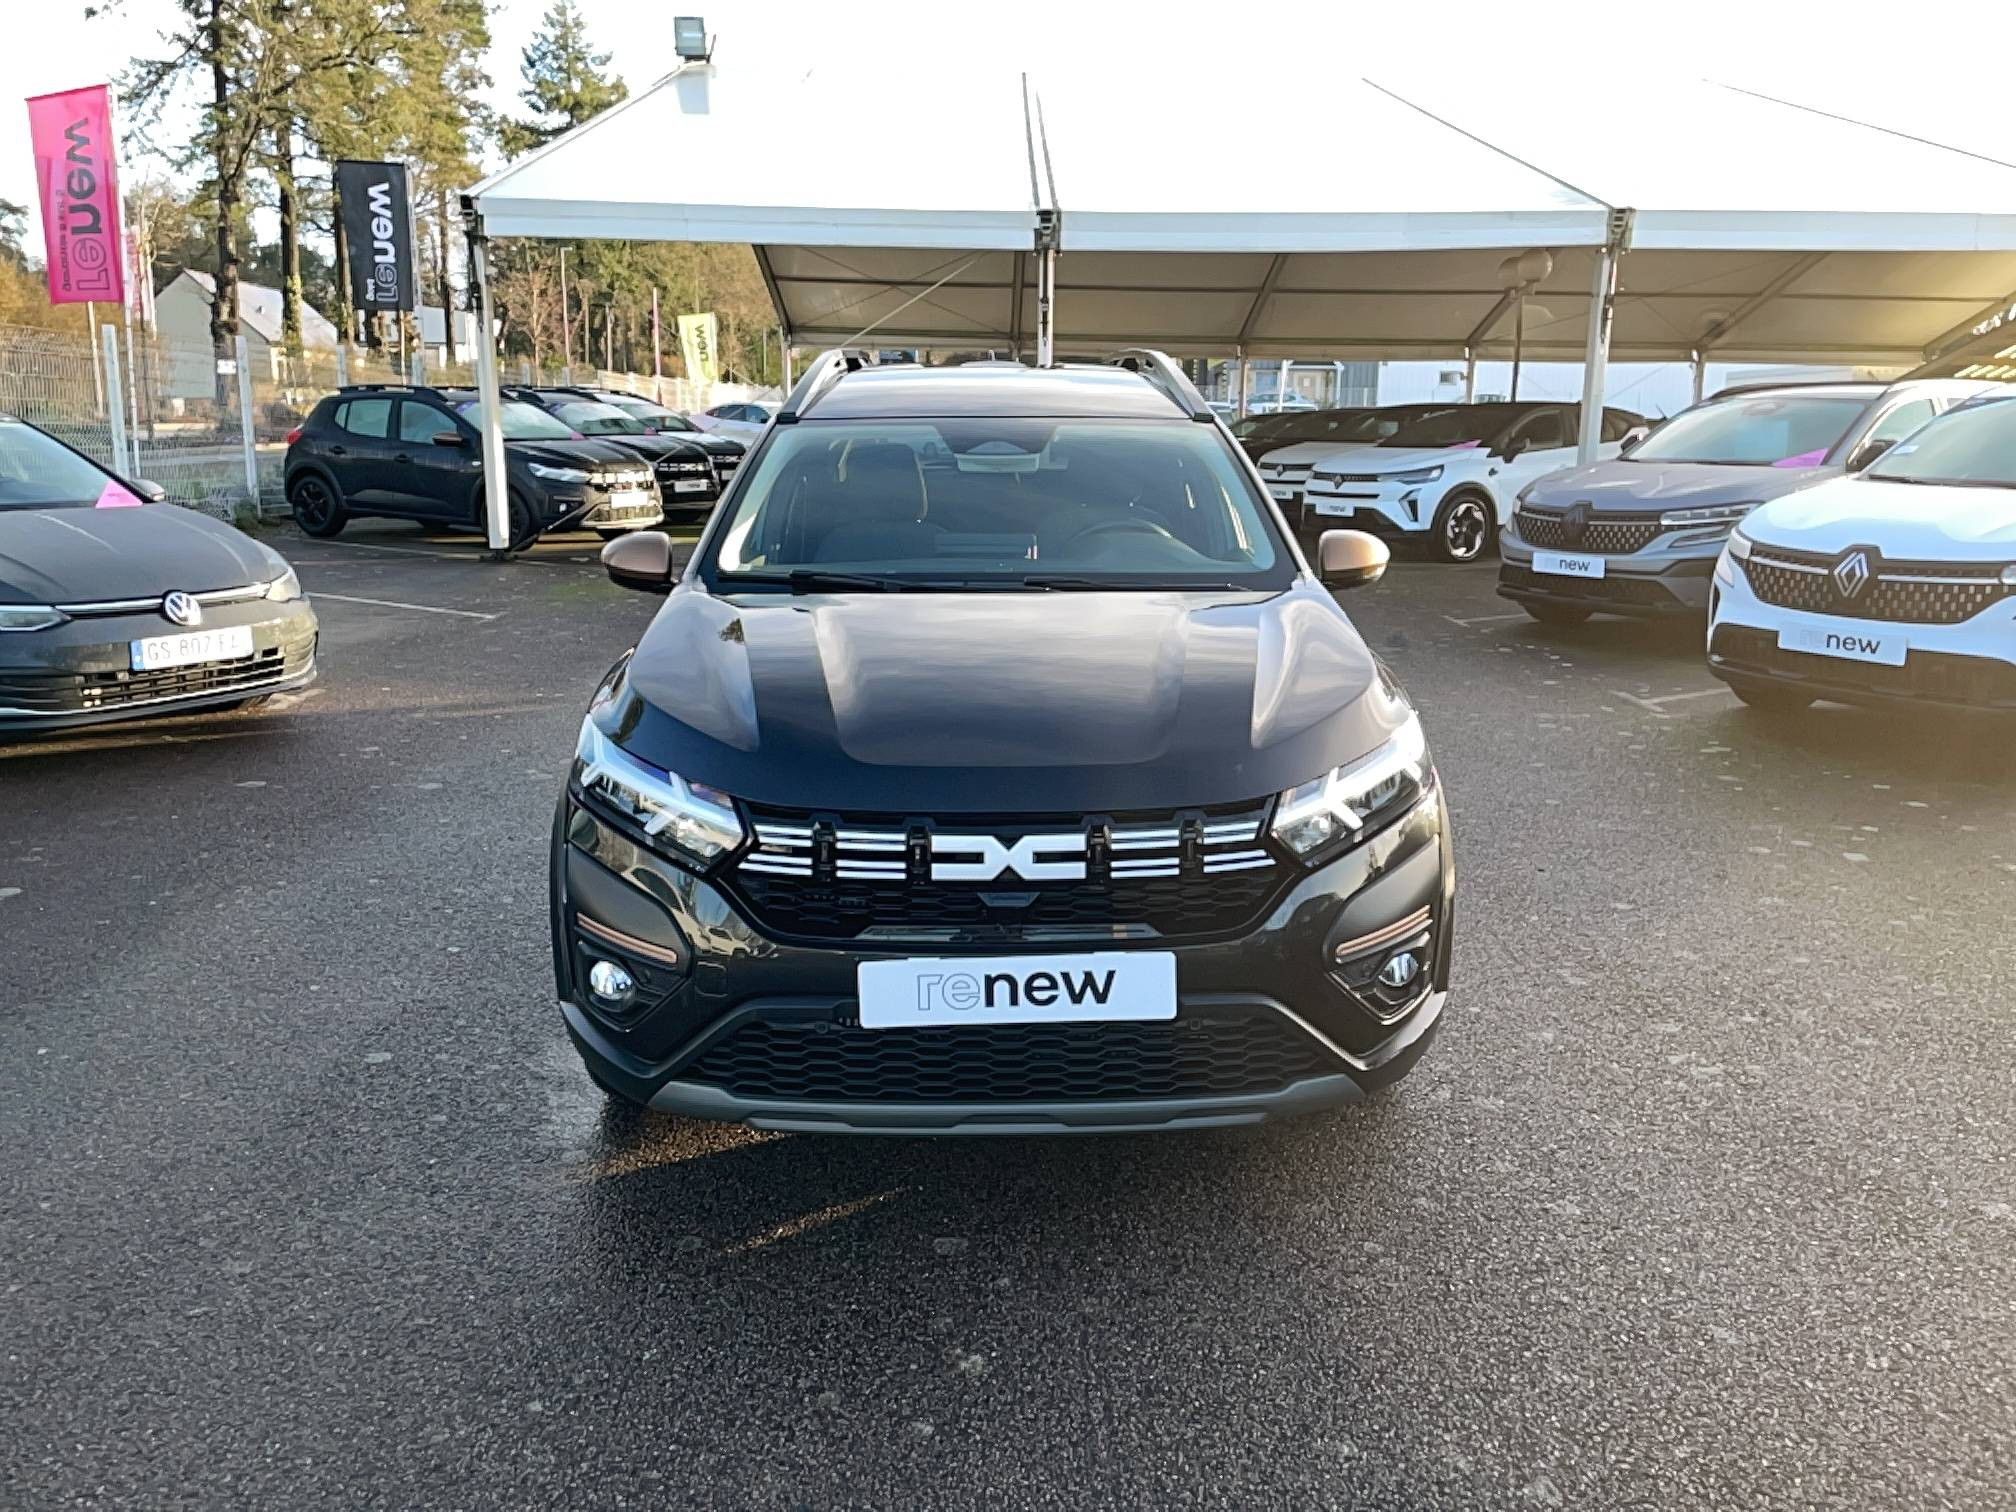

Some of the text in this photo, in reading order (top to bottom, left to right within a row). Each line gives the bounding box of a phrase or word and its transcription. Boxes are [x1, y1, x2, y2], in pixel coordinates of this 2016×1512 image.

[64, 117, 110, 291] renew
[367, 182, 399, 302] renew
[147, 641, 171, 661] GS
[916, 969, 1117, 1012] renew
